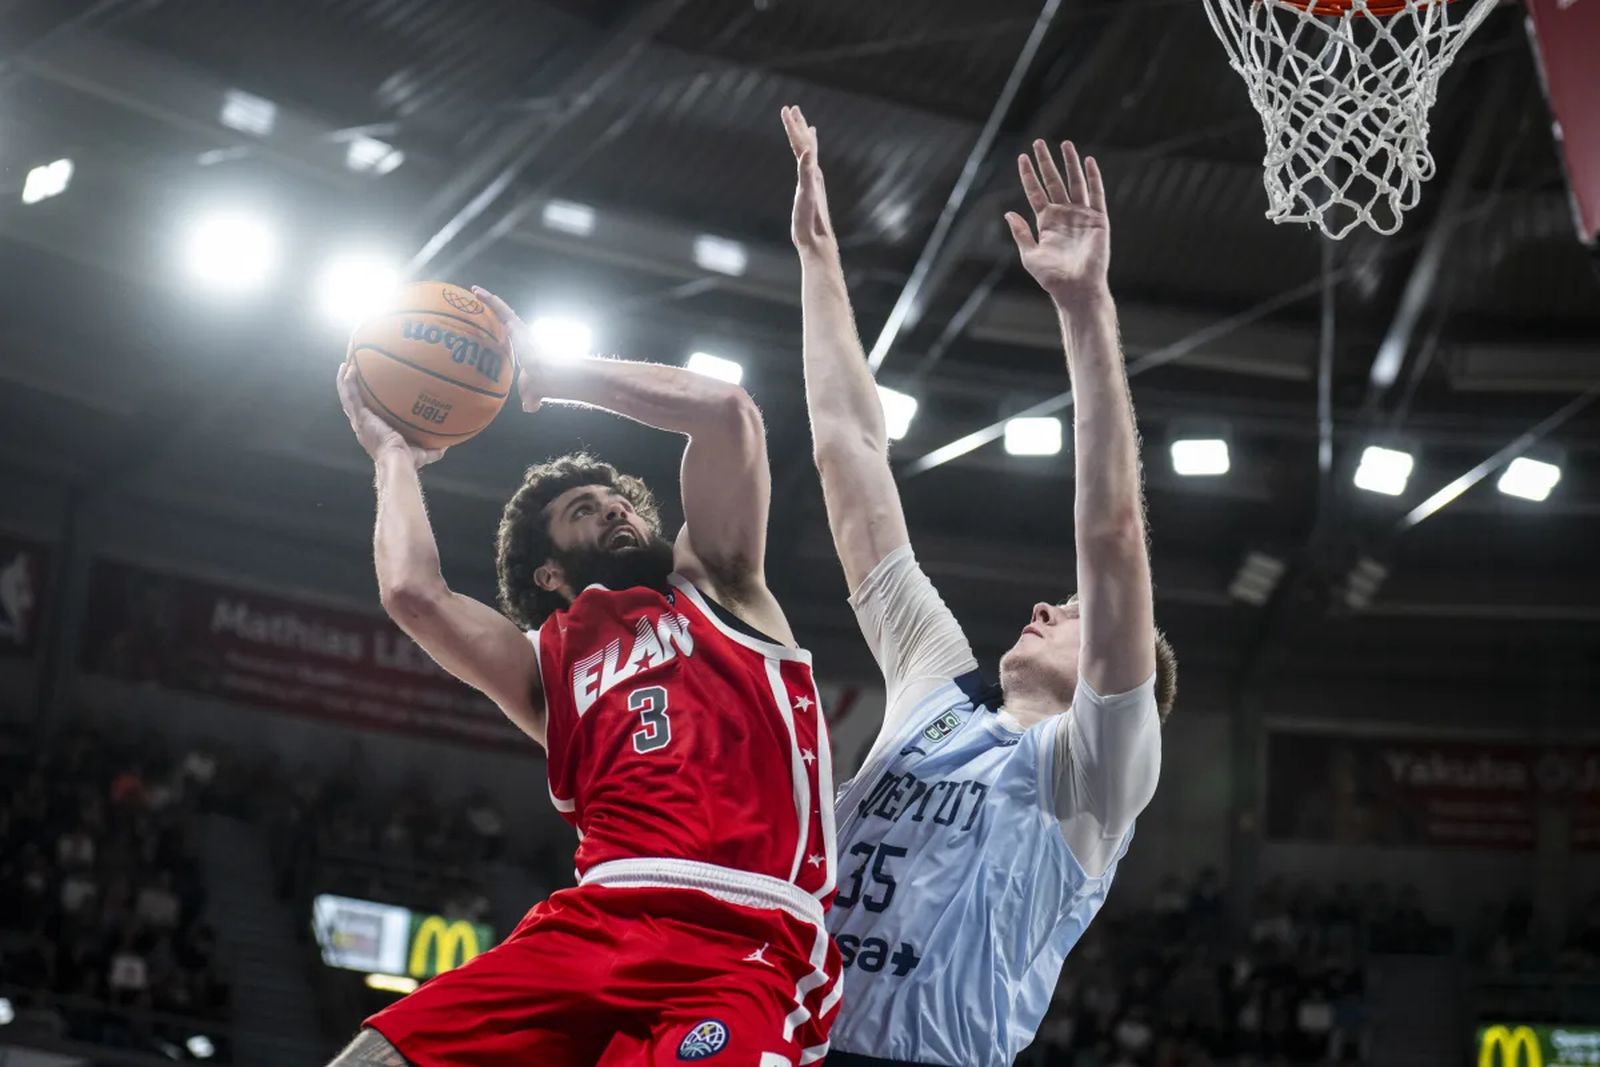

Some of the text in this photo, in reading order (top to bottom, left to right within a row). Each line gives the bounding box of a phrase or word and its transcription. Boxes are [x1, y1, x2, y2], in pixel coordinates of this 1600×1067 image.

[403, 319, 503, 383] Wilson
[411, 400, 449, 425] FIBA
[573, 611, 694, 718] ELAN
[628, 685, 671, 754] 3
[834, 841, 908, 914] 35
